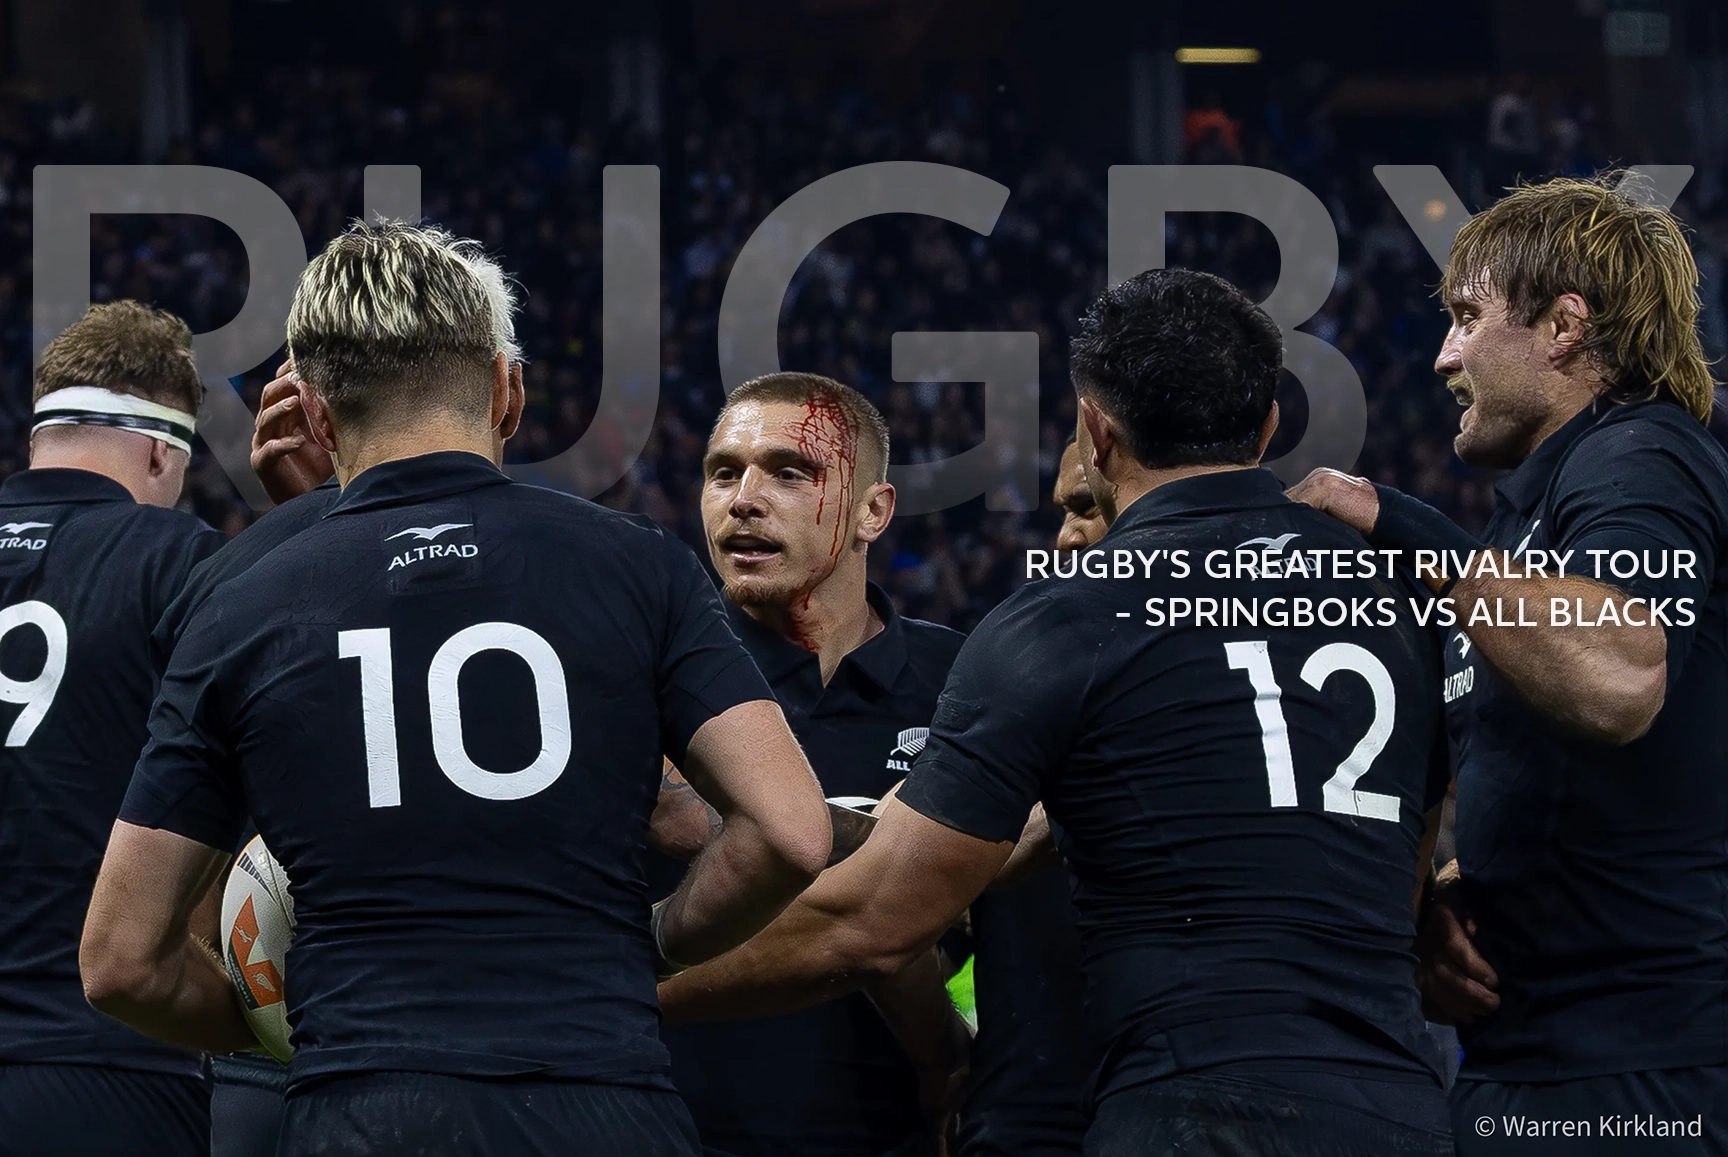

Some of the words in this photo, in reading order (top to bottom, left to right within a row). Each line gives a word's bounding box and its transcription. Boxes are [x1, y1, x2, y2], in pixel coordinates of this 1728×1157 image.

[387, 543, 479, 572] ALTRAD
[0, 600, 68, 747] 9
[338, 622, 572, 808] 10
[1223, 641, 1401, 823] 12
[886, 759, 911, 771] ALL
